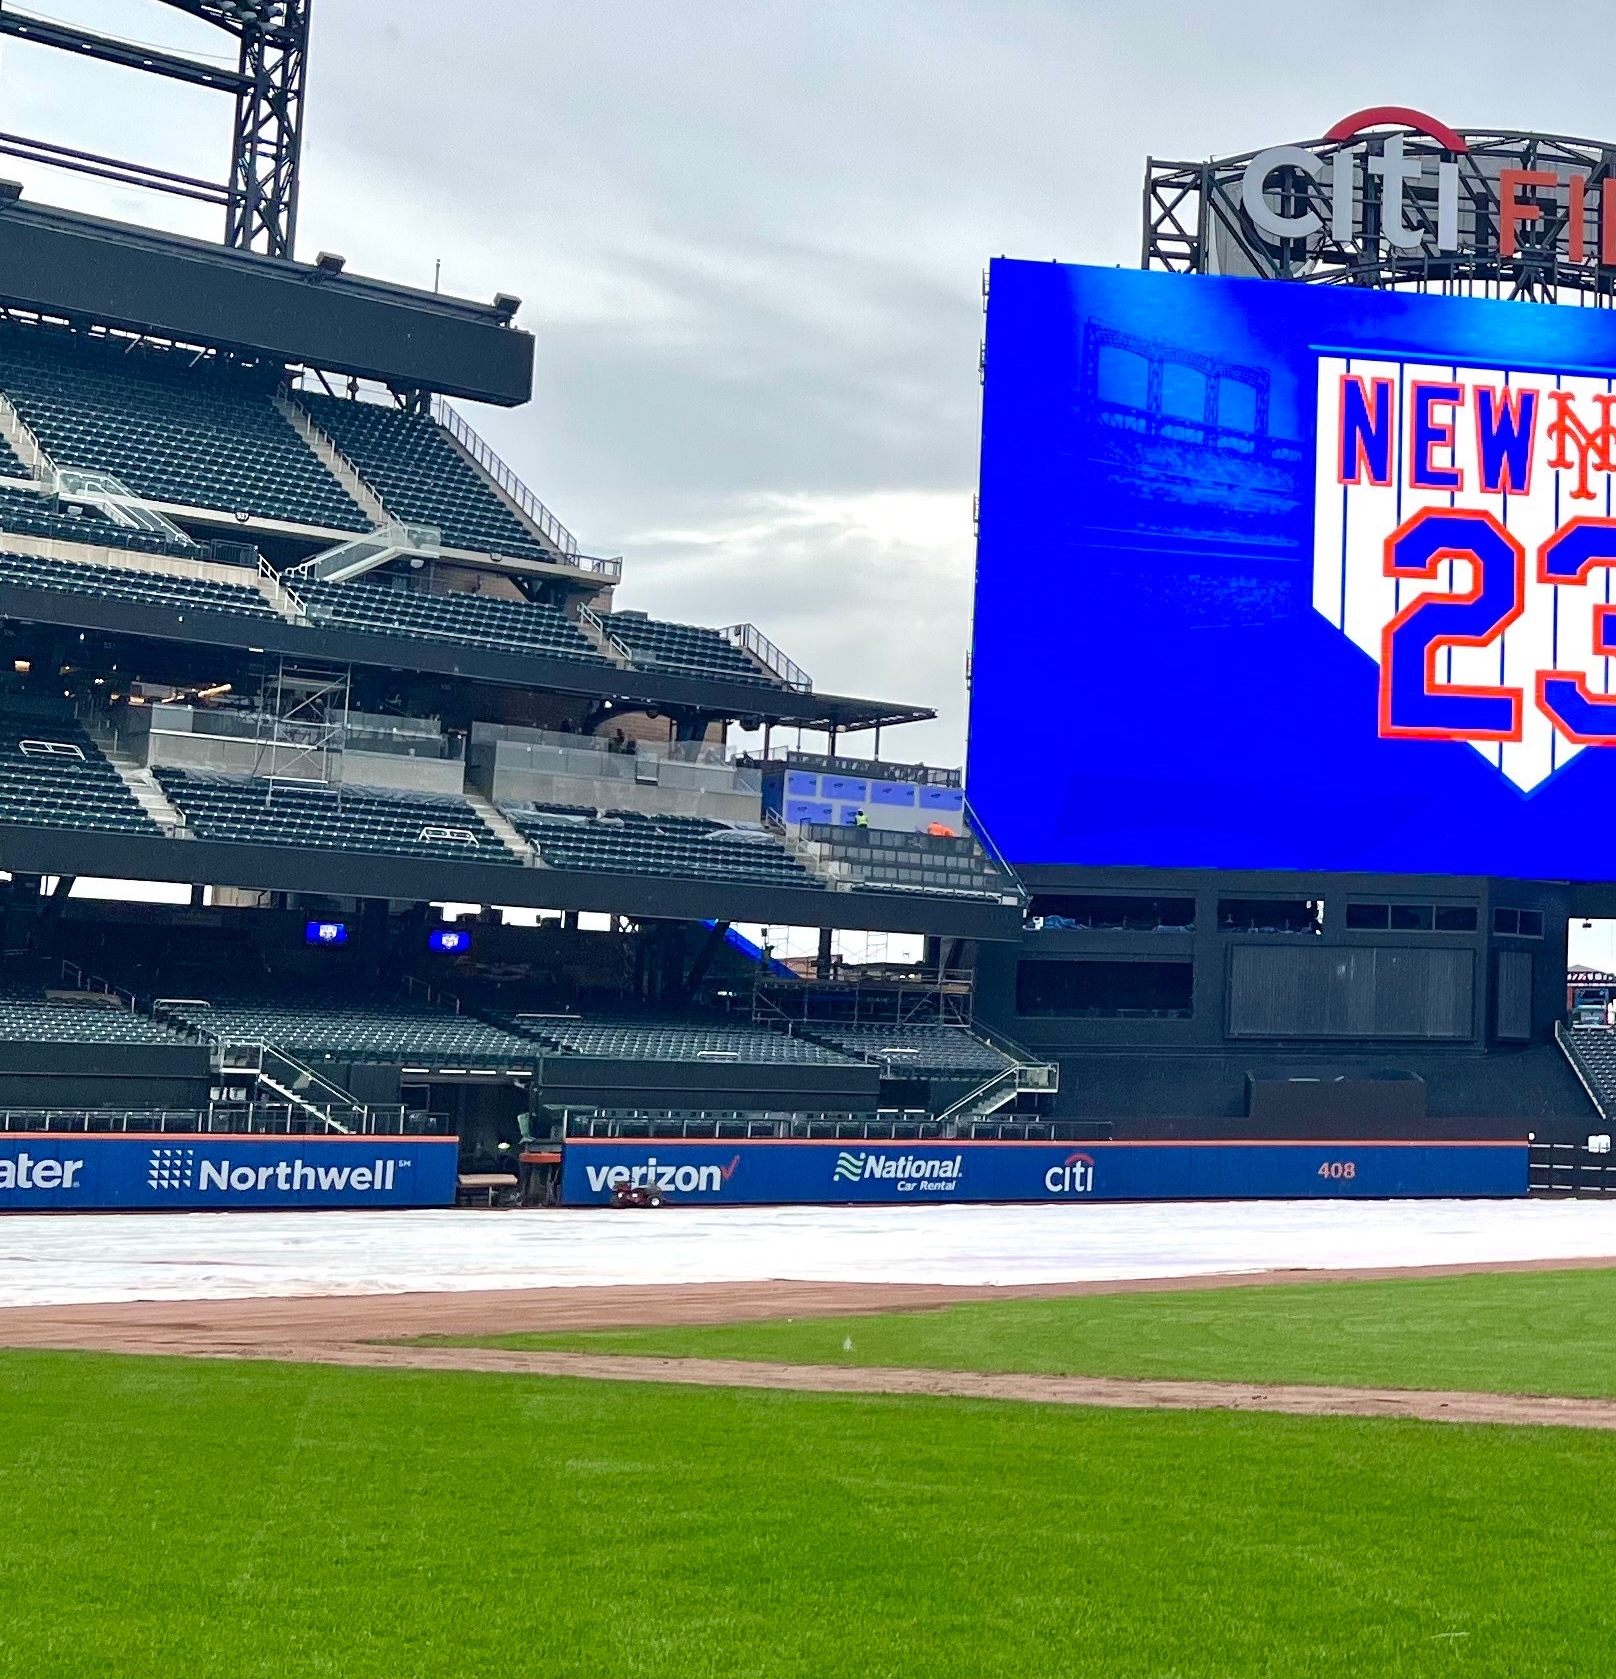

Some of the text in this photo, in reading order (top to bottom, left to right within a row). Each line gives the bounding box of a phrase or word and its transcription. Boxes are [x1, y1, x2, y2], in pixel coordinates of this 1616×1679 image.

[1242, 132, 1459, 253] citi
[1337, 374, 1540, 496] NEW
[0, 1153, 84, 1188] ater
[200, 1160, 395, 1191] Northwell
[586, 1158, 722, 1192] verizon
[864, 1155, 962, 1178] National
[1045, 1160, 1093, 1192] citi
[1317, 1161, 1356, 1180] 408
[897, 1180, 956, 1191] Car Rental
